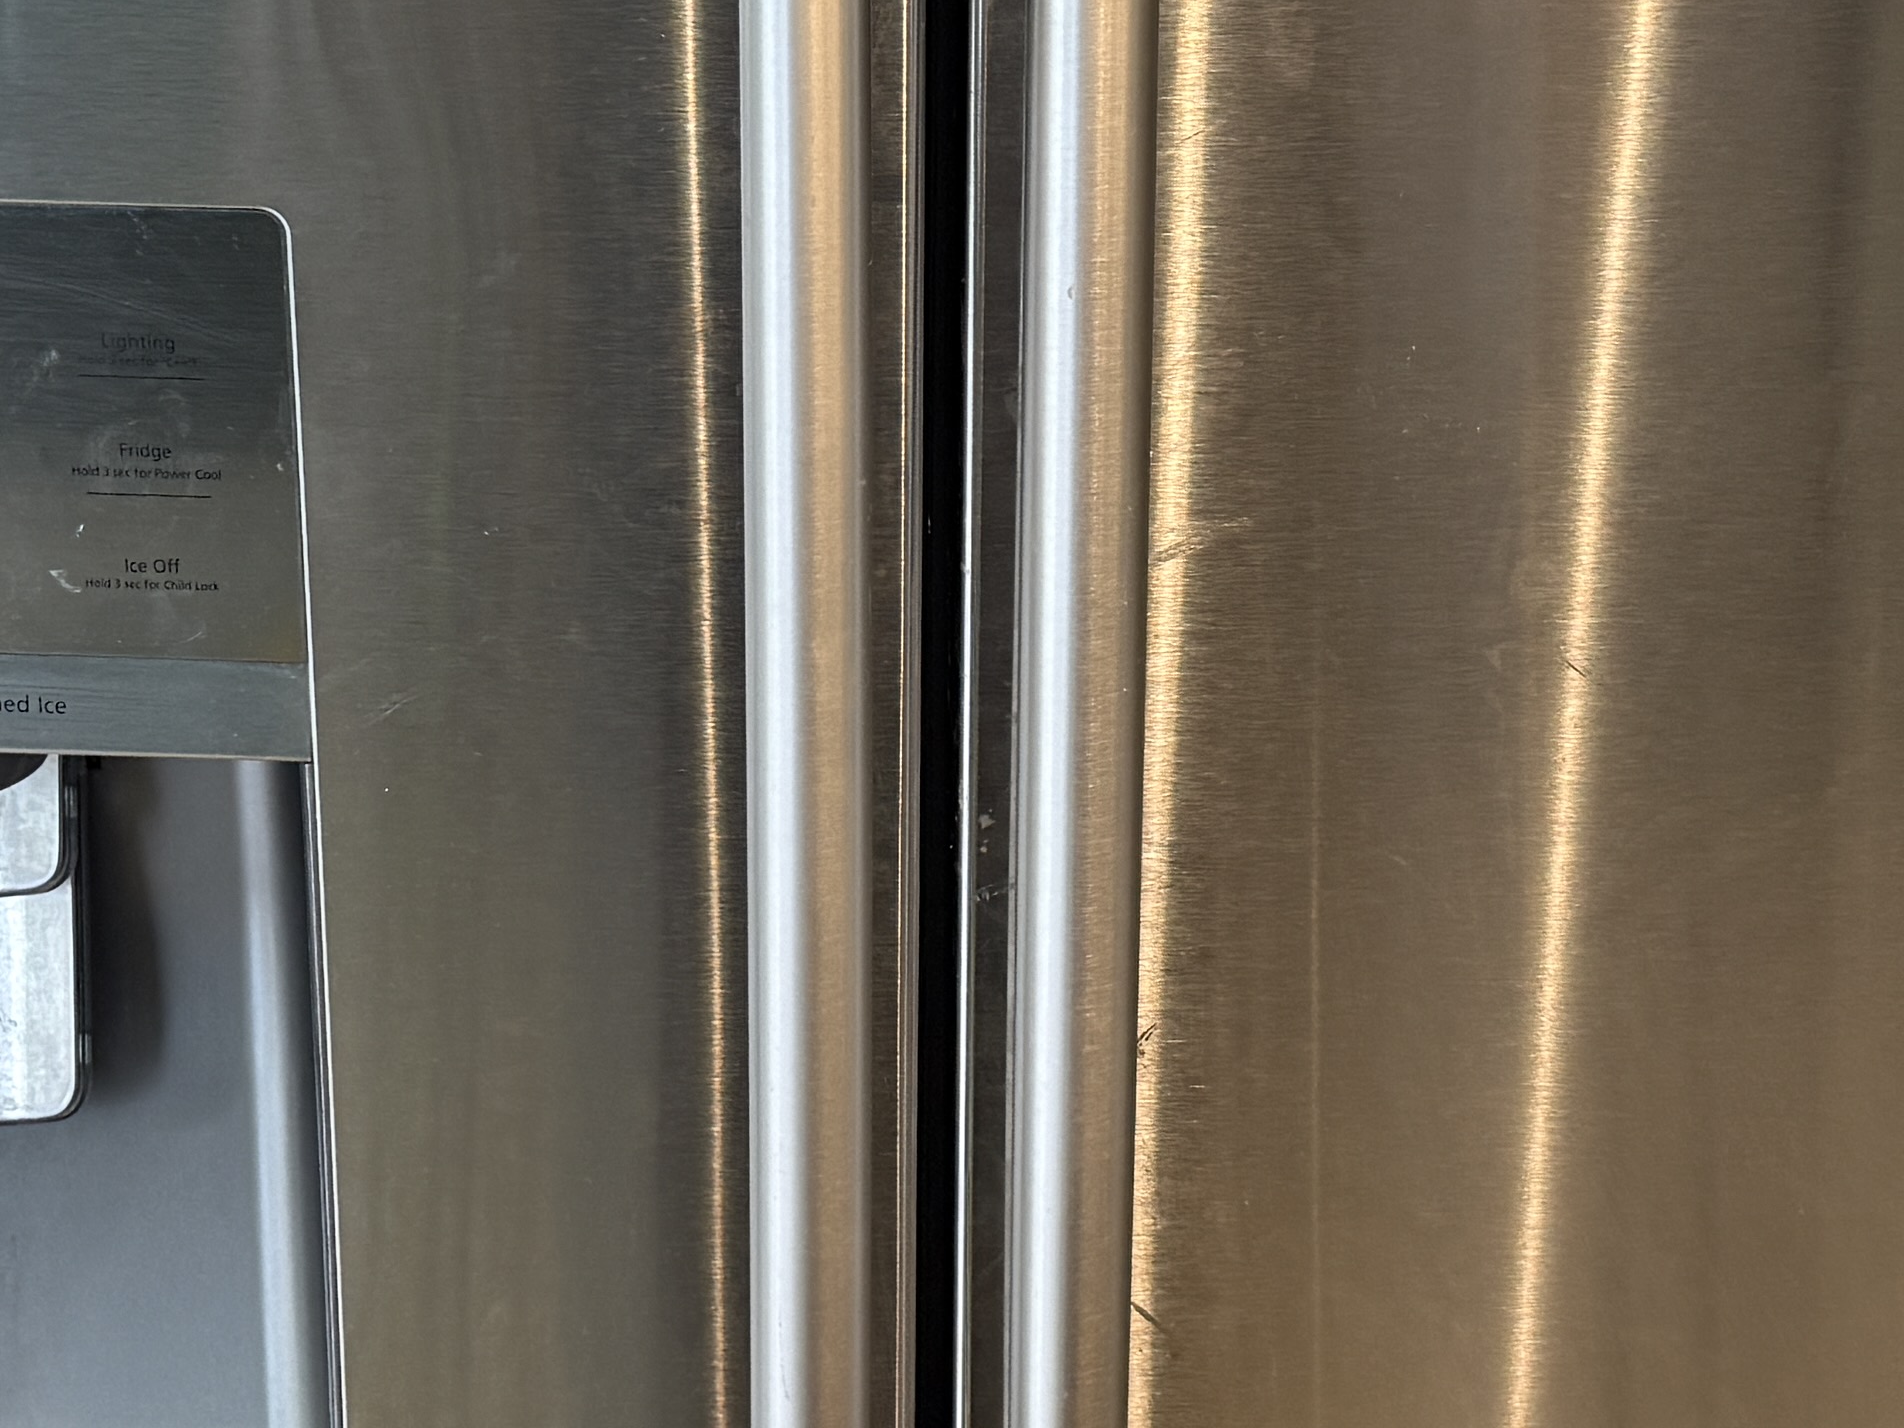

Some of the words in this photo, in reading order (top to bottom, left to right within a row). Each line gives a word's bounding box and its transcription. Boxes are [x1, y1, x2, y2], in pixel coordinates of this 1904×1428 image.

[101, 332, 176, 355] Lighting
[119, 442, 172, 461] Fridge
[195, 468, 222, 480] Cool
[124, 558, 148, 573] Ice
[153, 558, 181, 573] Off
[85, 577, 111, 588] Hold
[115, 578, 122, 589] 3
[144, 579, 160, 590] for
[163, 580, 193, 591] Child
[37, 694, 68, 716] Ice
